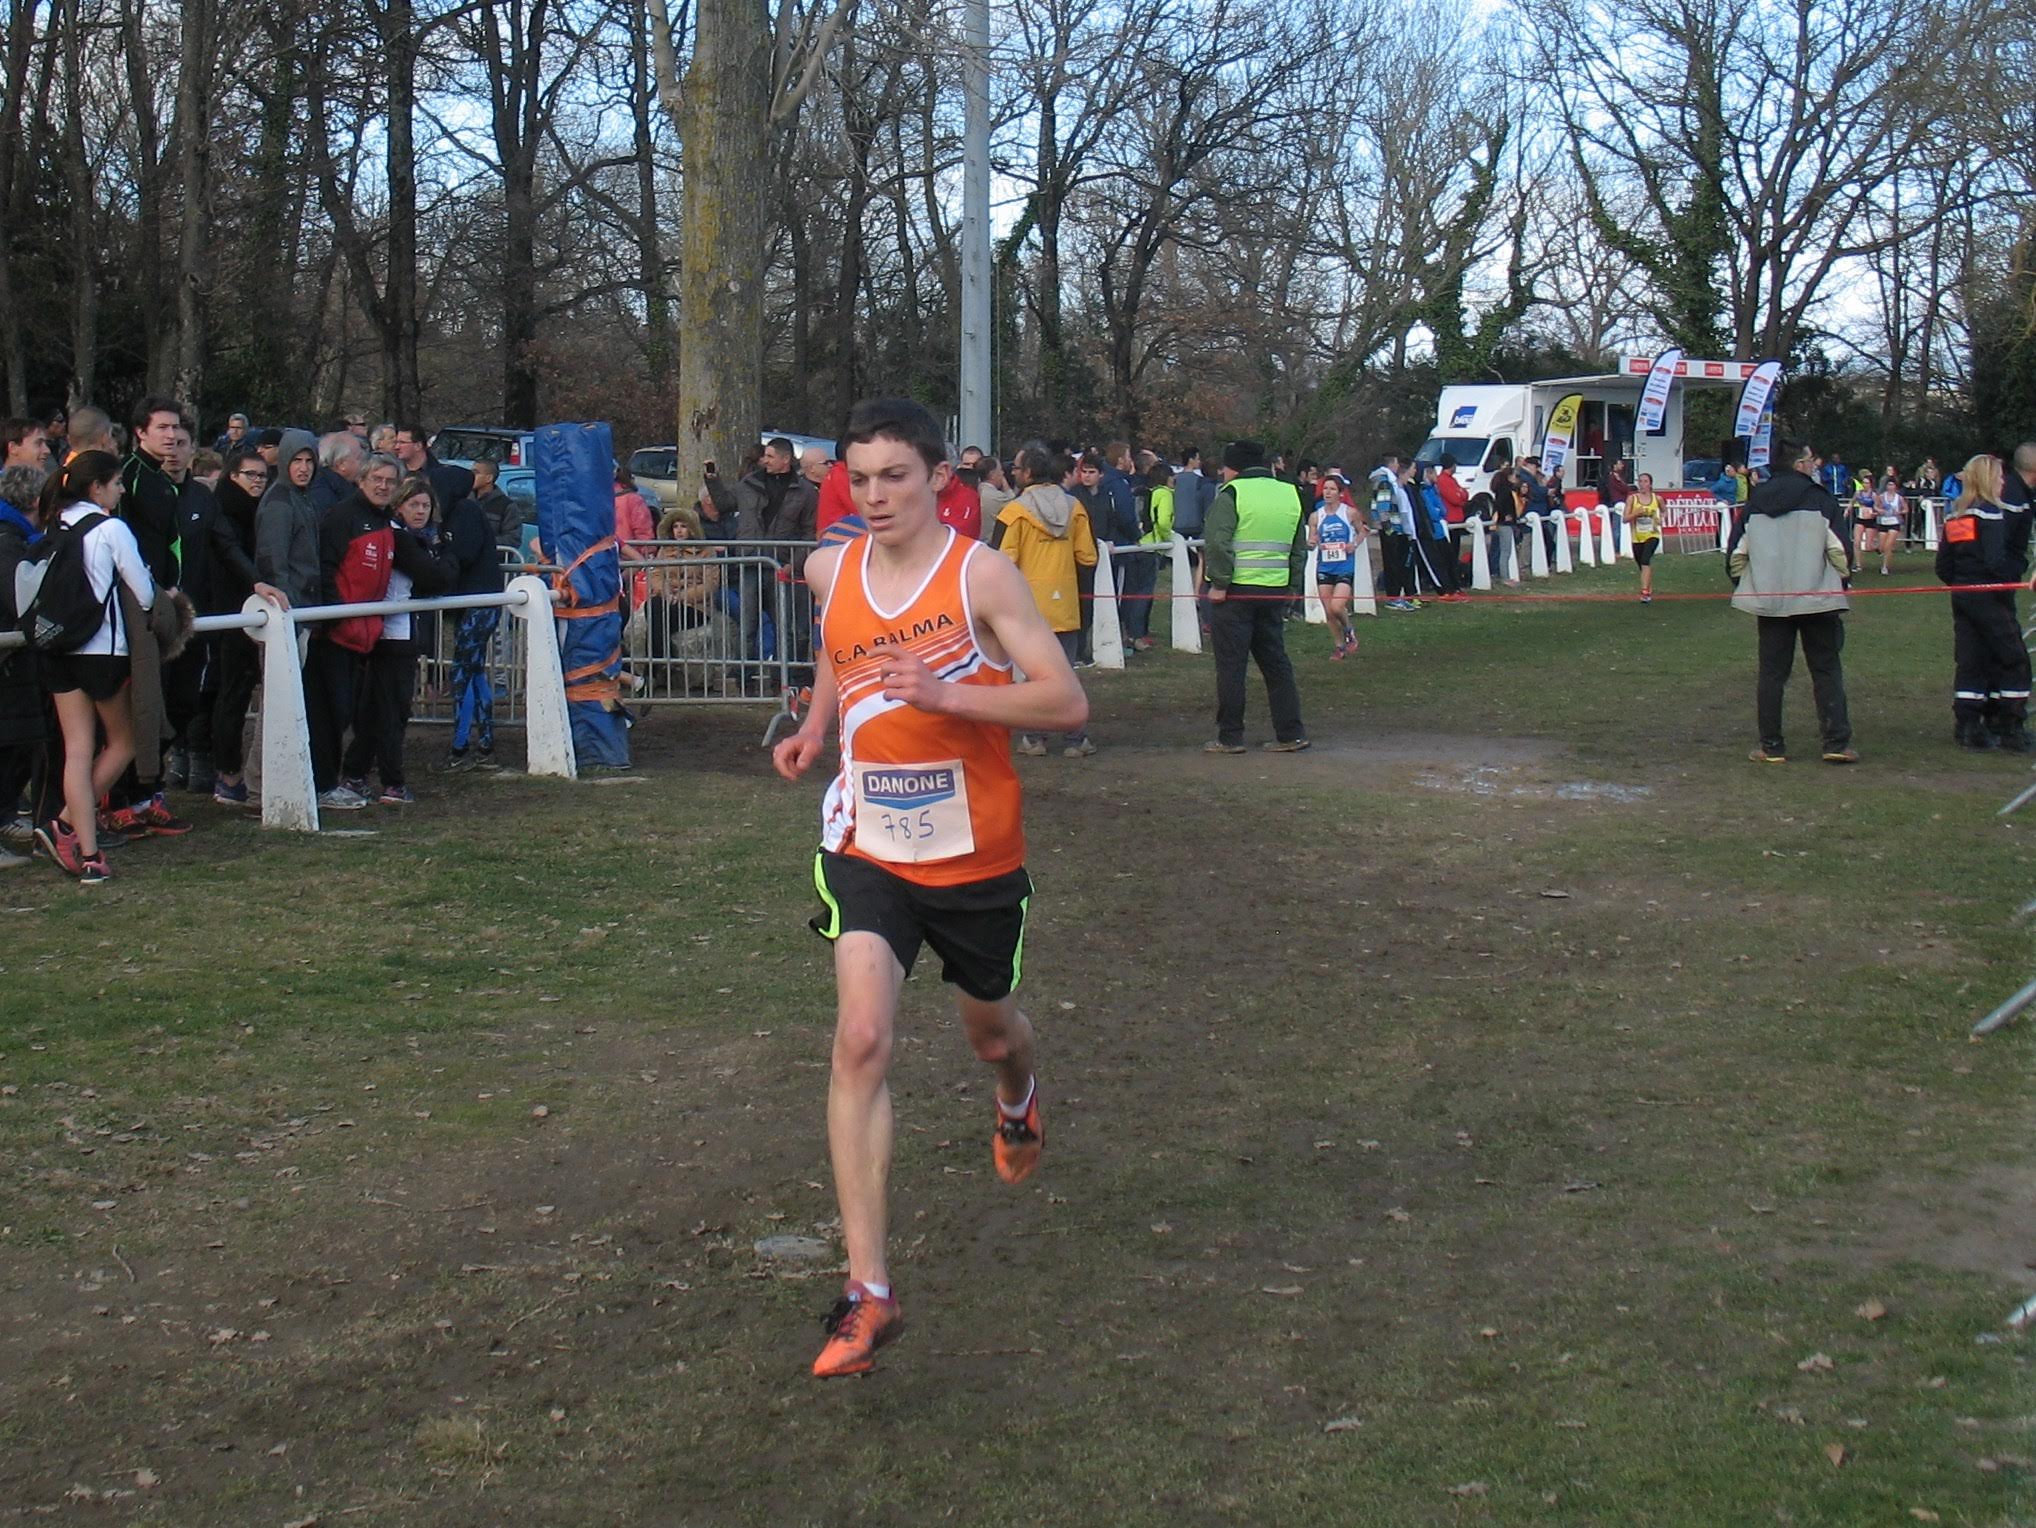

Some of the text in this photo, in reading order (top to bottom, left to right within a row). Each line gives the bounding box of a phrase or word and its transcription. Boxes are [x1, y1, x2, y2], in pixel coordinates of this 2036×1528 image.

[873, 613, 954, 648] BALMA
[867, 772, 949, 794] DANONE
[881, 810, 935, 842] 785
